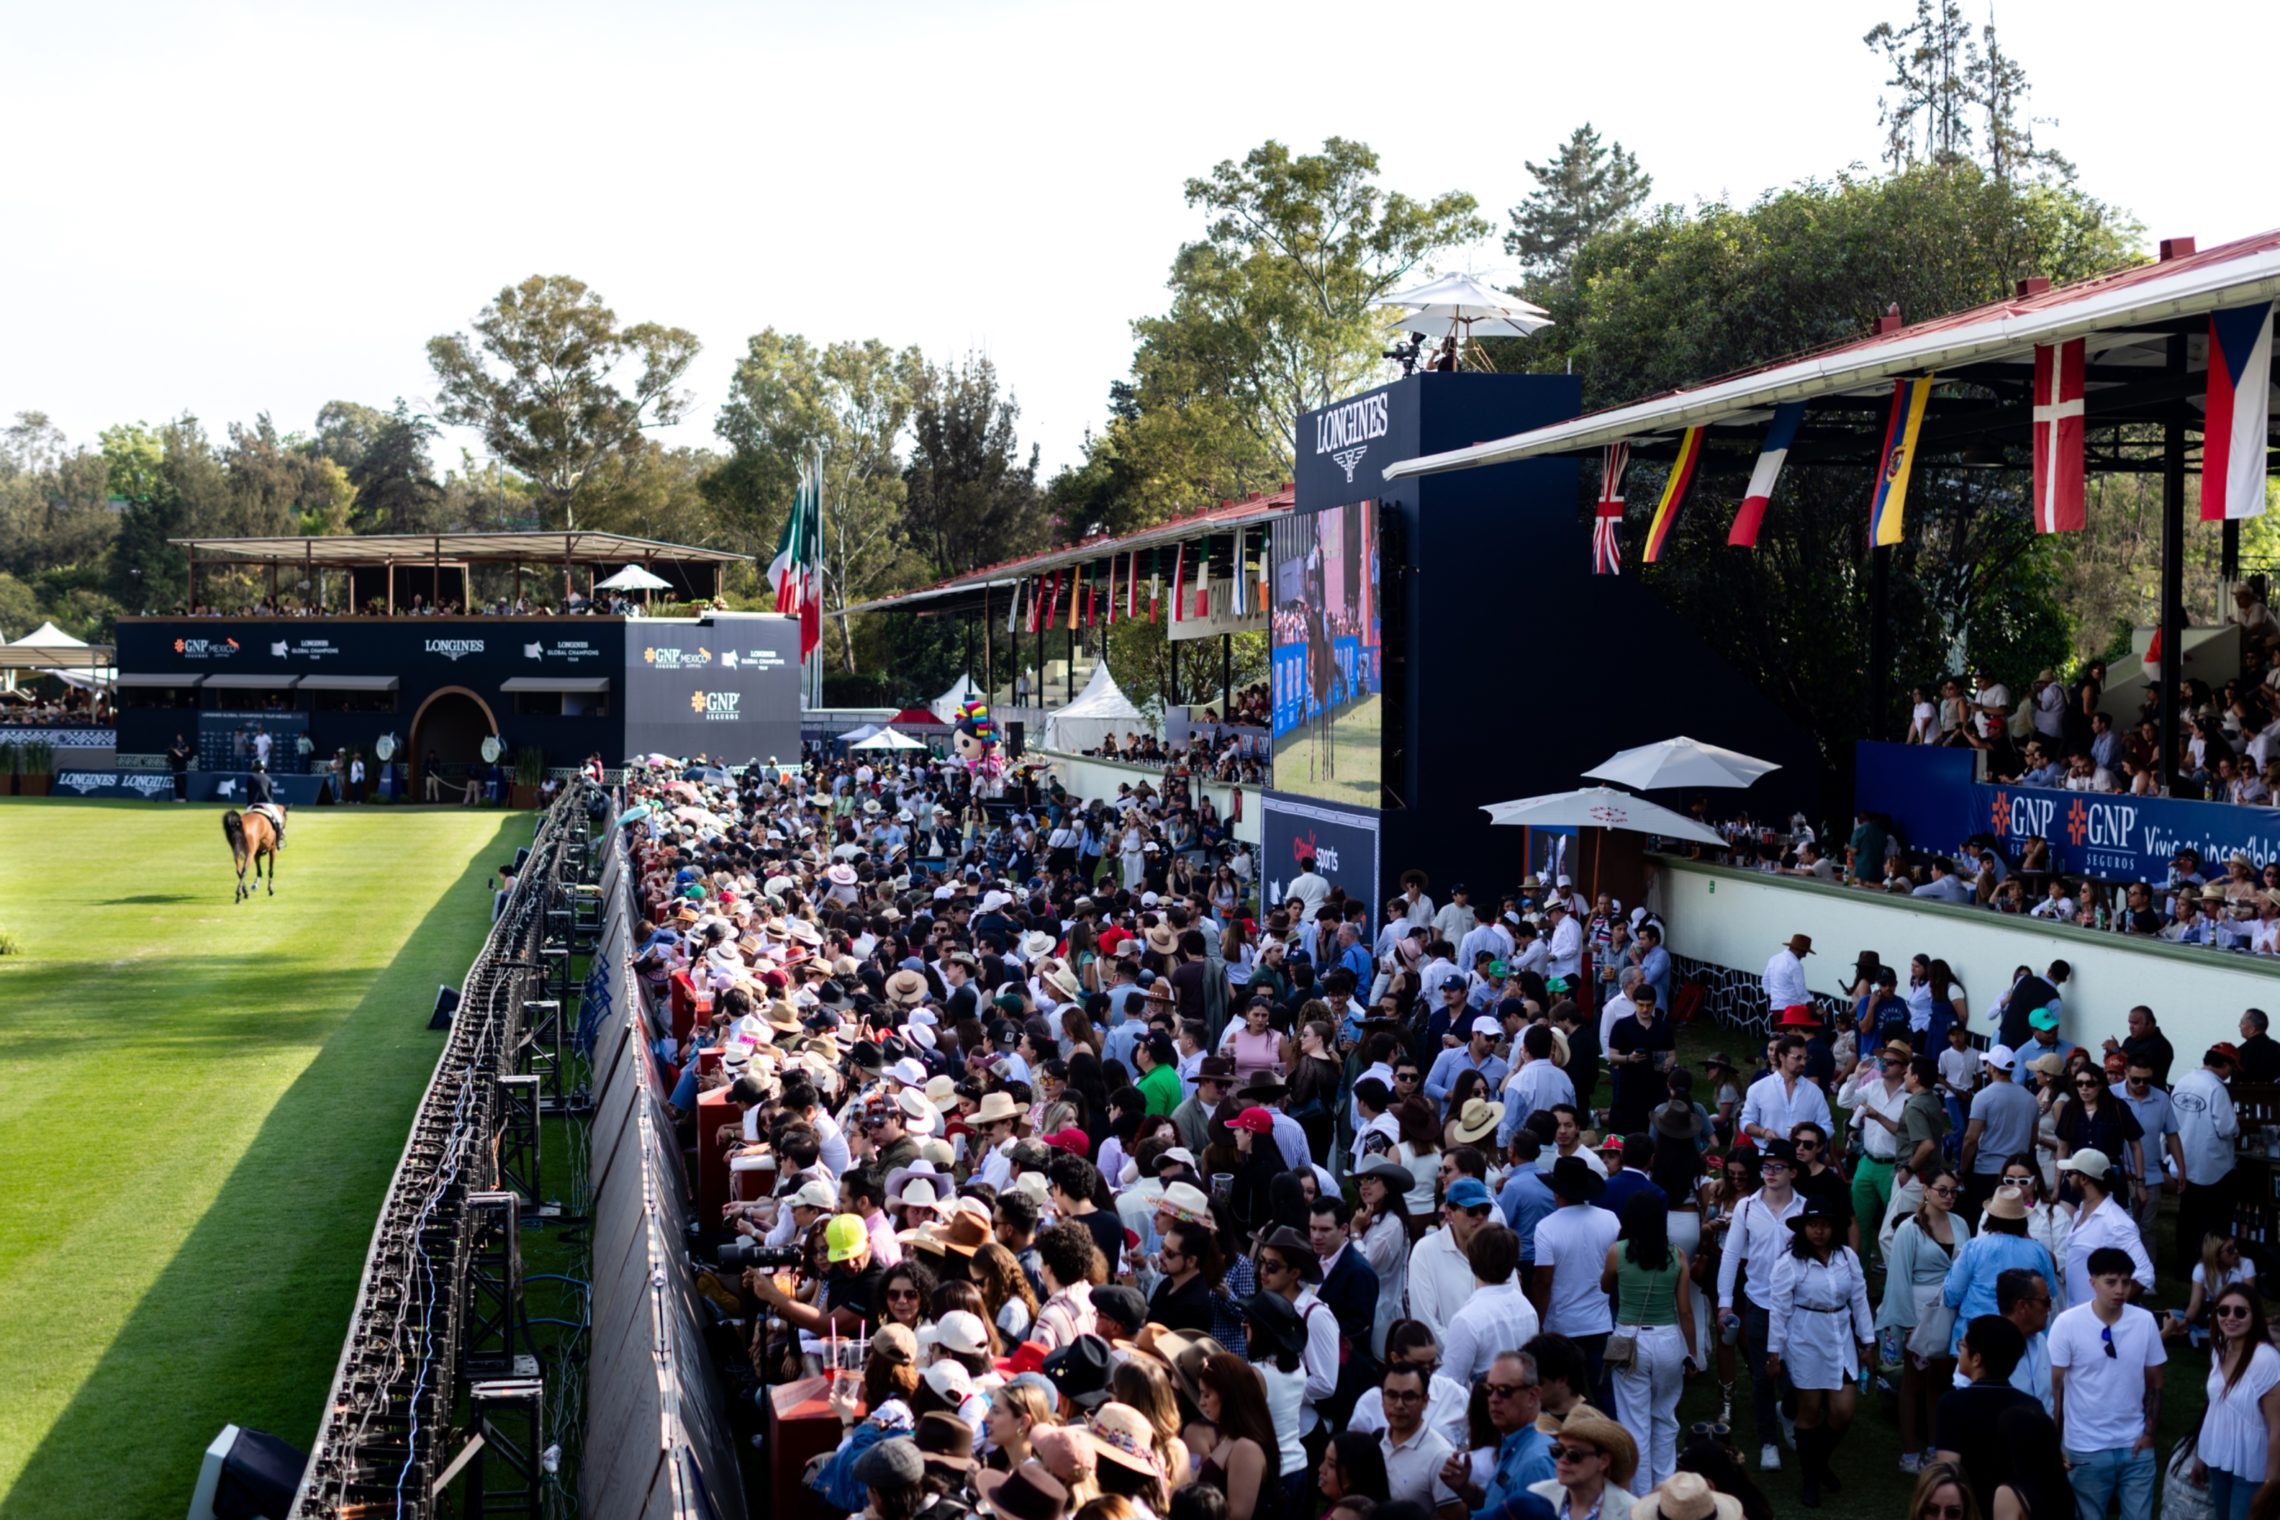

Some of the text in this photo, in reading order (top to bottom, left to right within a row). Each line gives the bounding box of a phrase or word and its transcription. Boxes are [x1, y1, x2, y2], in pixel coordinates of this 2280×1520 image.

[1316, 392, 1388, 454] LONGINES
[185, 639, 209, 653] GNP
[425, 639, 484, 652] LONGINES
[557, 641, 589, 649] LONGINES
[655, 648, 681, 663] GNP
[706, 692, 738, 711] GNP
[58, 773, 117, 786] LONGINES
[2011, 796, 2054, 838] GNP
[2088, 803, 2135, 847] GNP
[1316, 845, 1339, 875] sports
[2086, 853, 2135, 871] SEGUROS
